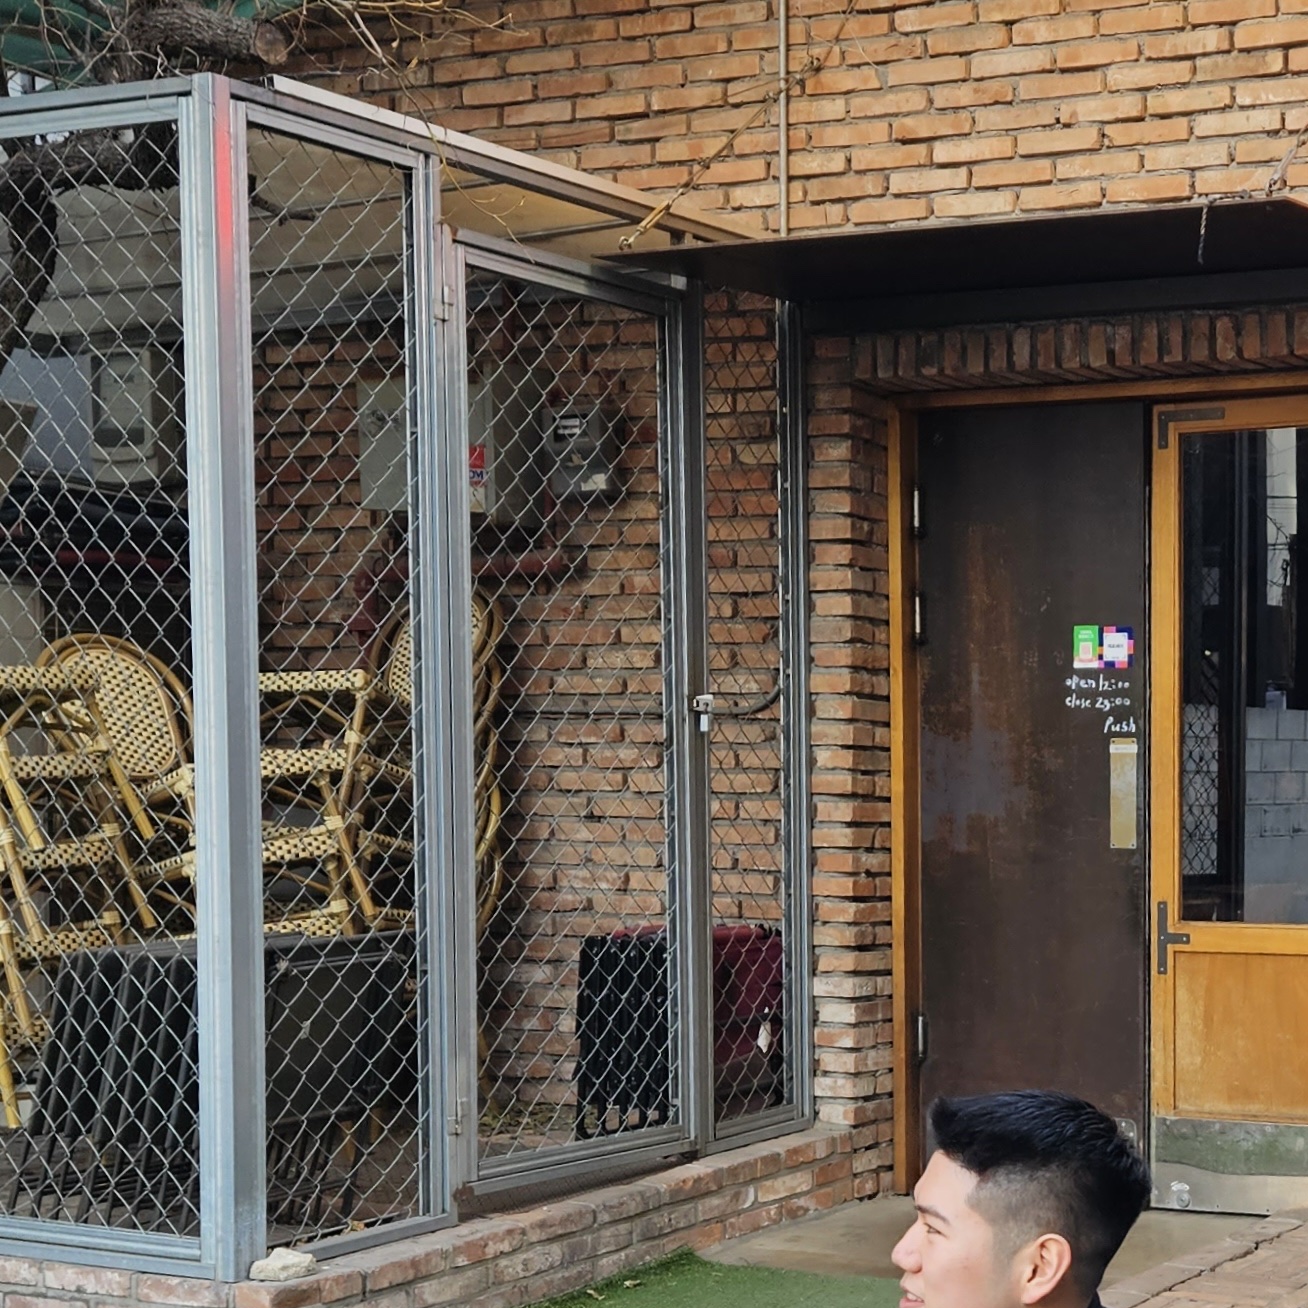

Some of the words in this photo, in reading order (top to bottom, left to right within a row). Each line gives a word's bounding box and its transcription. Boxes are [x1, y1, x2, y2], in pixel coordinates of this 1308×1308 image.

[1099, 673, 1130, 691] 12:00
[1065, 692, 1091, 708] close
[1095, 696, 1131, 711] 23:00
[1104, 716, 1136, 733] Push
